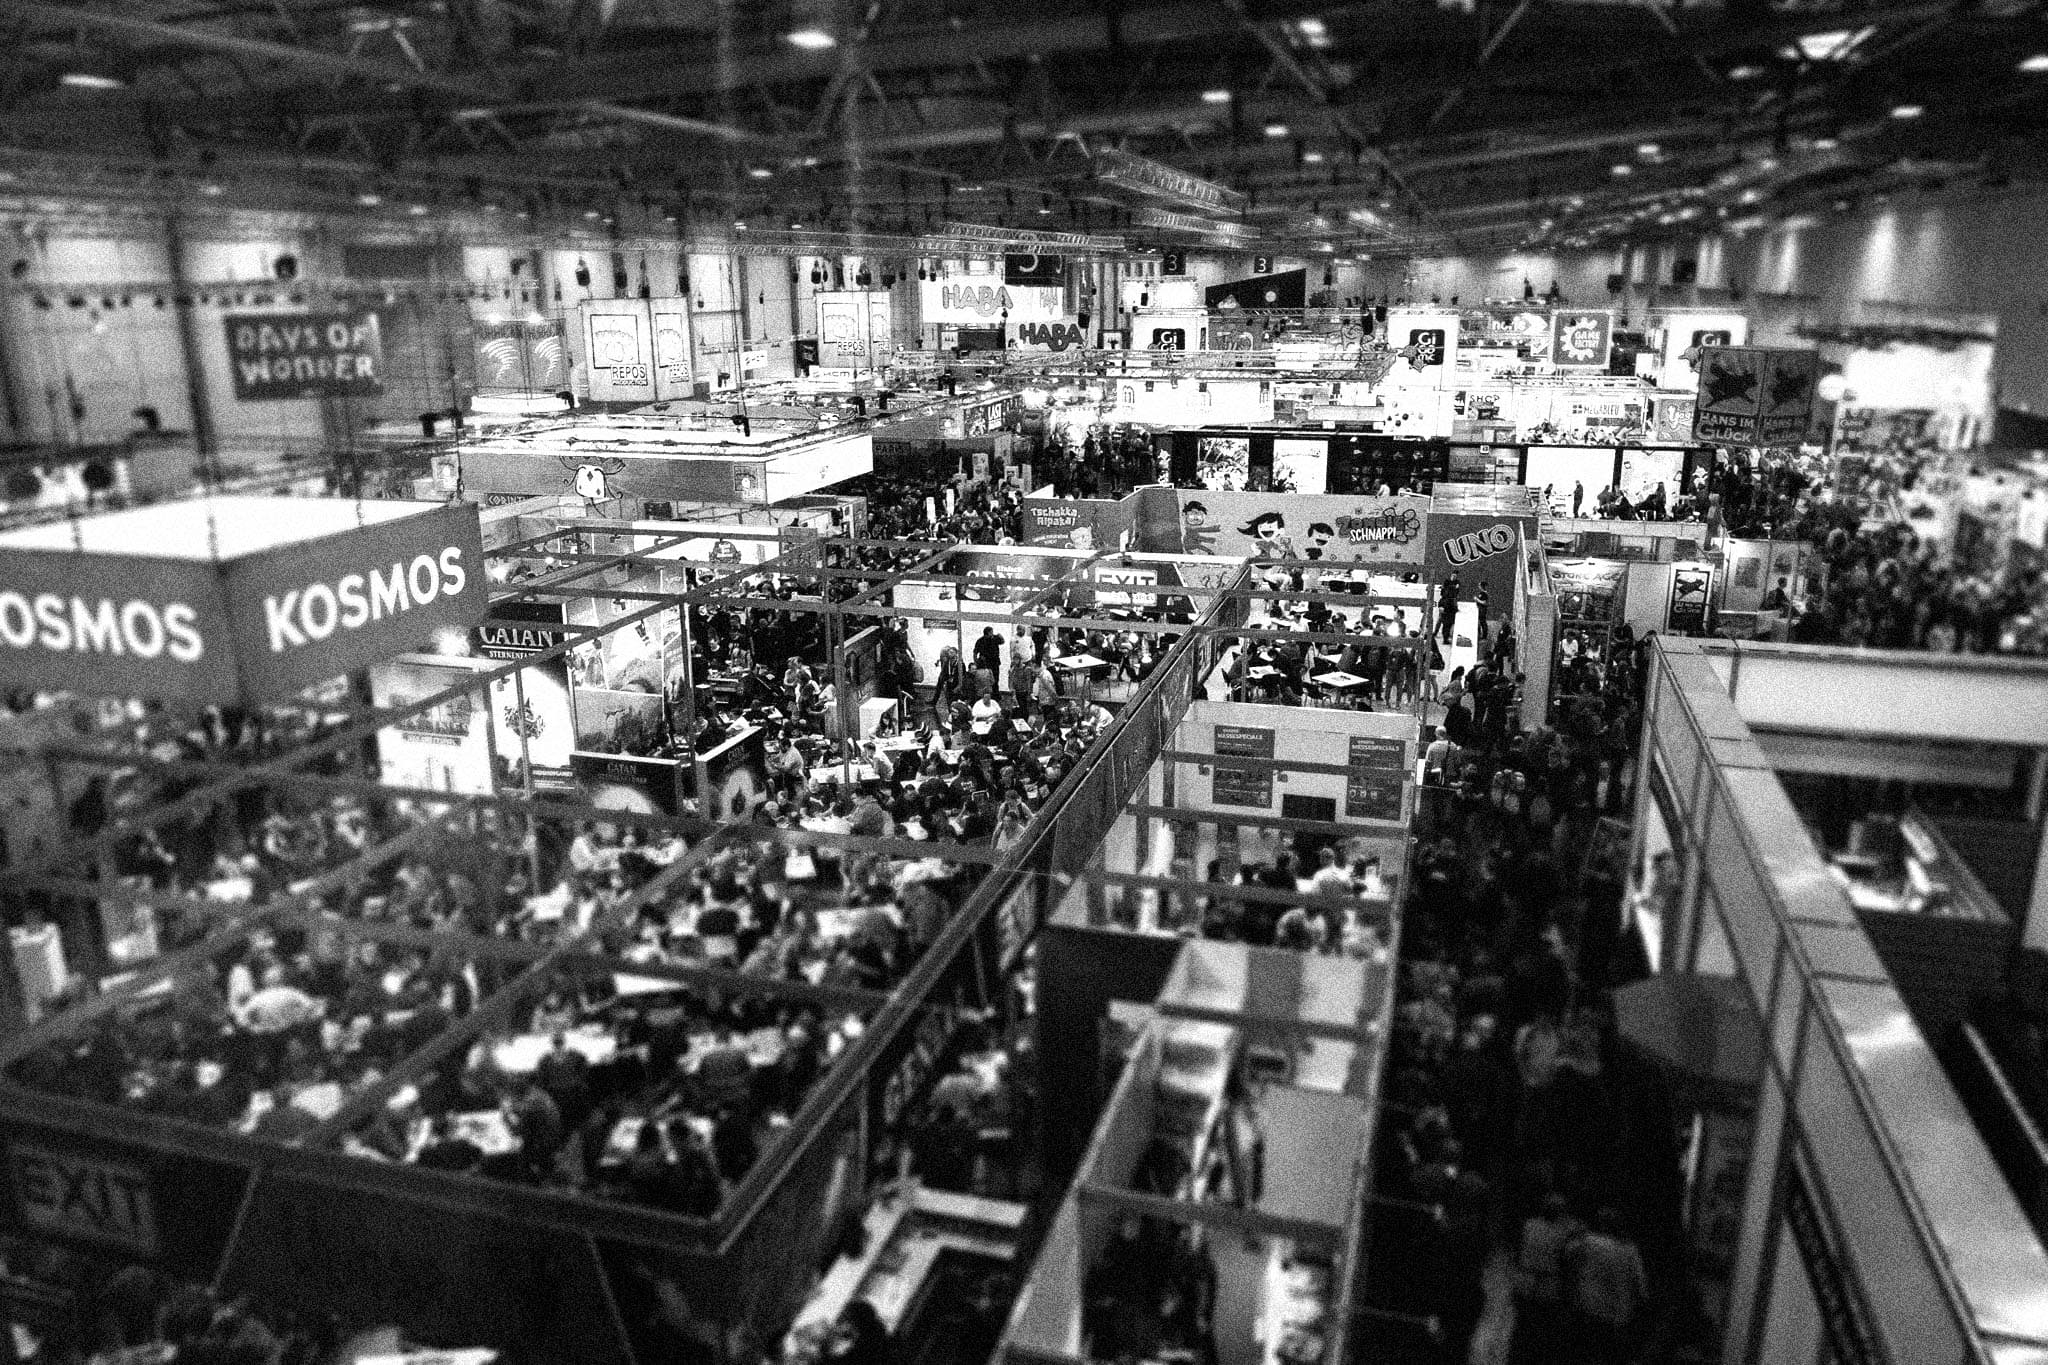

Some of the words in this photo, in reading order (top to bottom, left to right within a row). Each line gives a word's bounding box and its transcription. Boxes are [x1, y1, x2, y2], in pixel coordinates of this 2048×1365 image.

[1168, 254, 1178, 271] 3
[1257, 257, 1267, 272] 3
[942, 284, 1014, 317] HABA
[1019, 322, 1085, 351] HABA
[1160, 331, 1178, 344] Gi
[1417, 332, 1436, 345] Gi
[837, 341, 865, 351] REPOS
[612, 366, 646, 379] REPOS
[1443, 524, 1515, 565] UNO
[262, 546, 466, 653] KOSMOS
